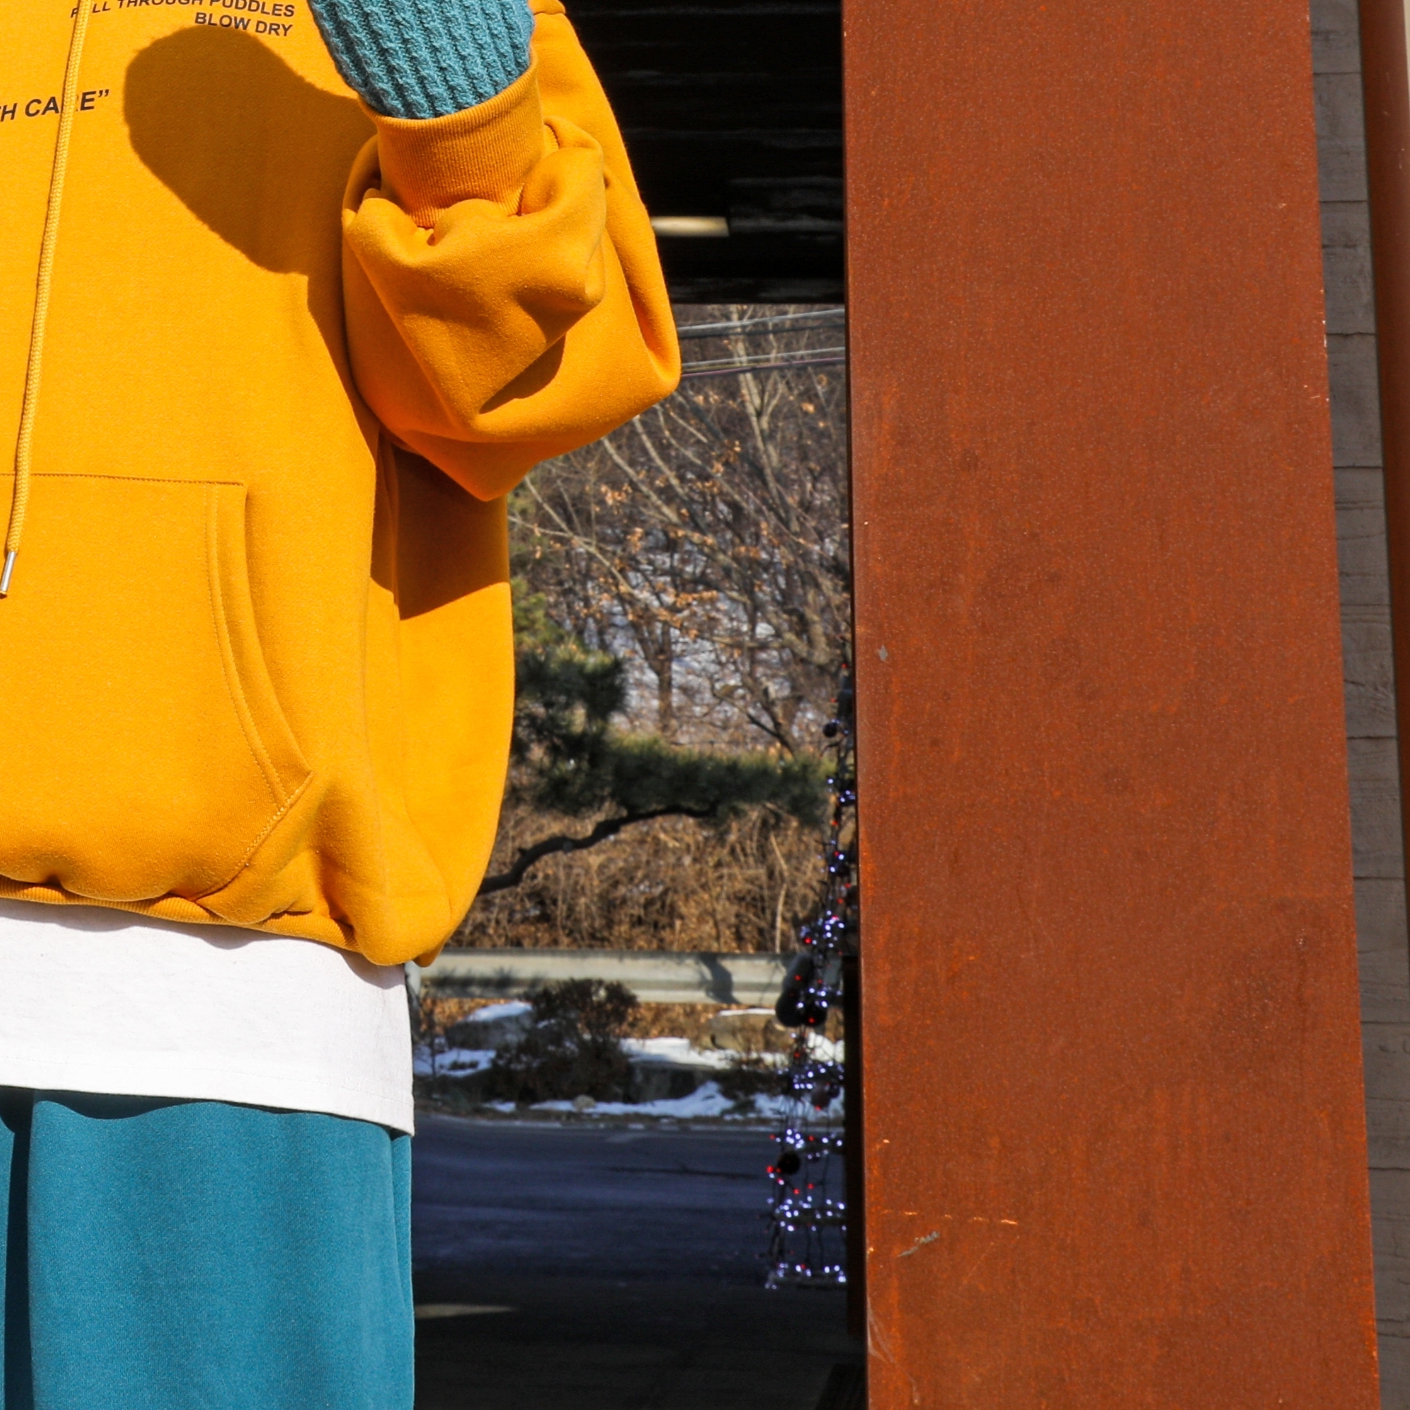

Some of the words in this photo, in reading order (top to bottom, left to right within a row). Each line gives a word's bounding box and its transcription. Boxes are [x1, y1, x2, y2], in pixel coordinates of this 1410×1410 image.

[194, 12, 252, 31] BLOW
[255, 20, 293, 37] DRY
[24, 89, 110, 117] CAE”
